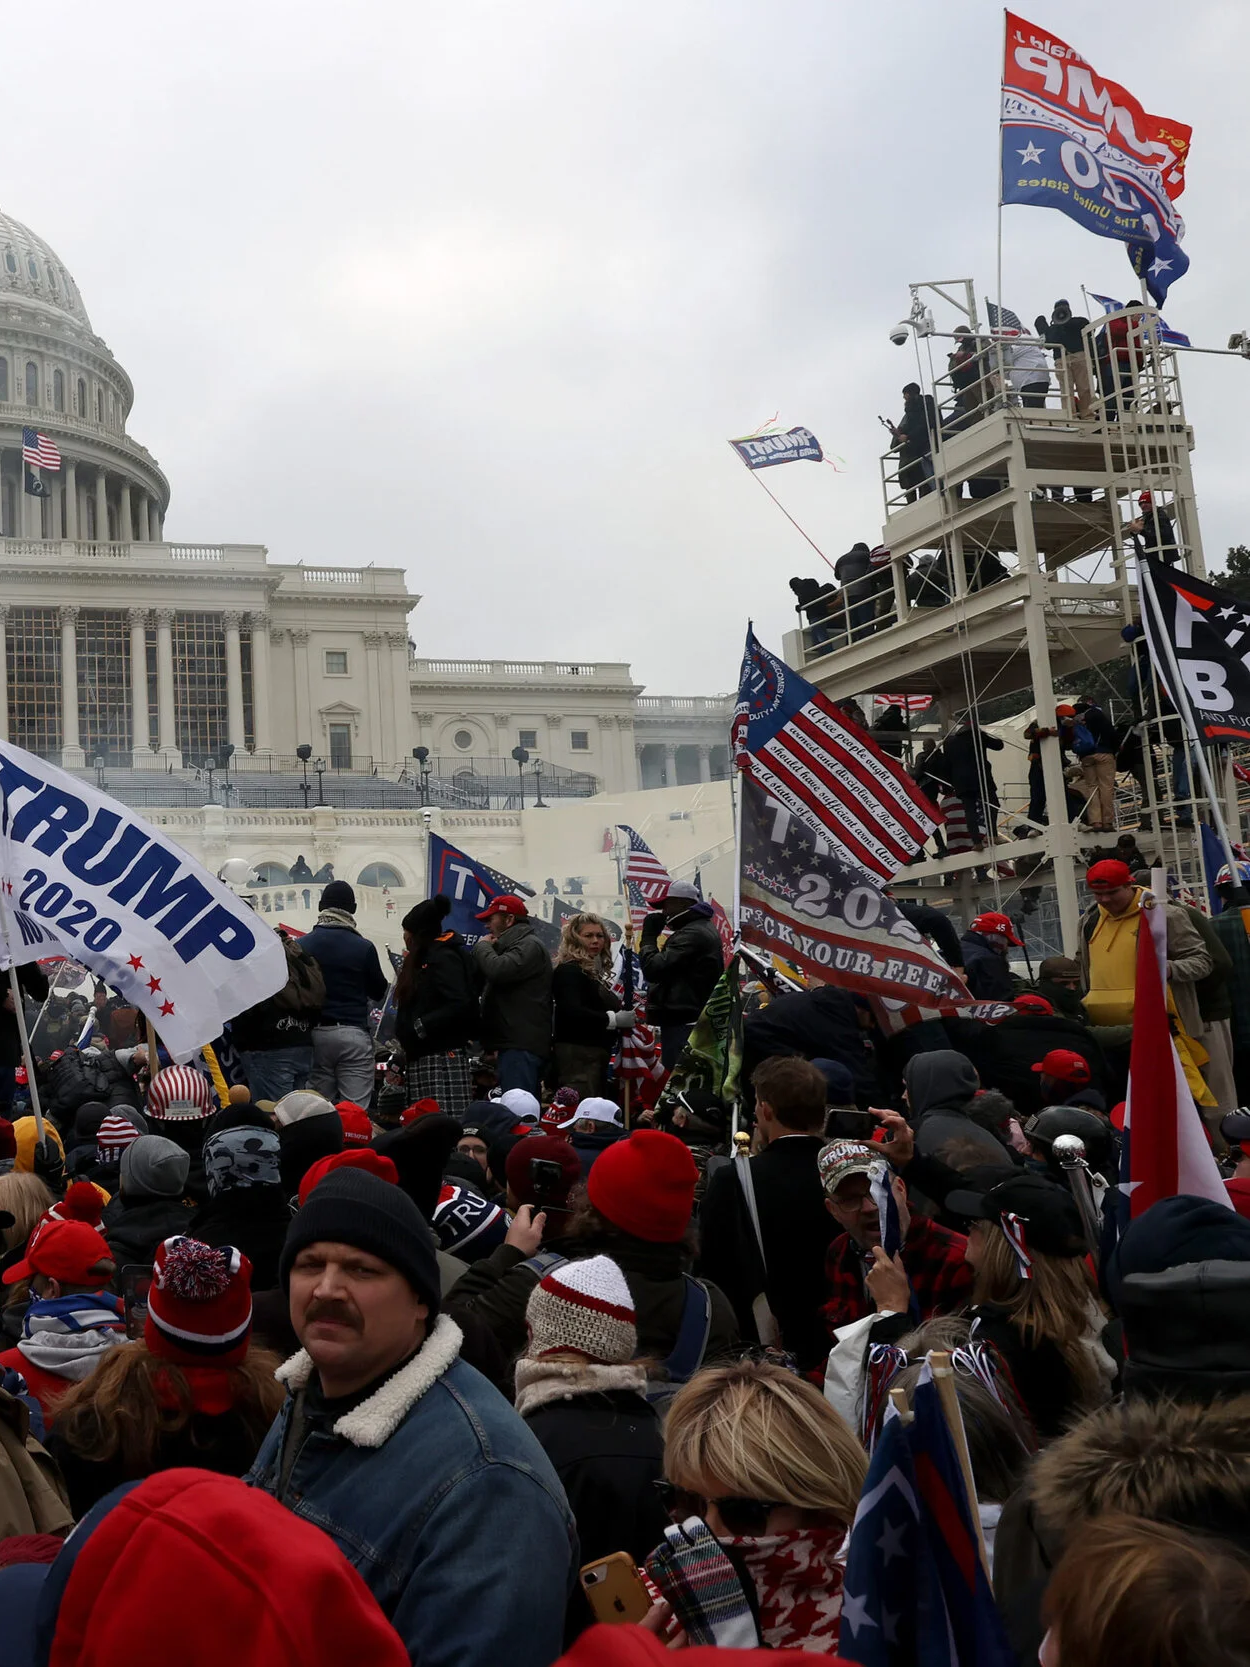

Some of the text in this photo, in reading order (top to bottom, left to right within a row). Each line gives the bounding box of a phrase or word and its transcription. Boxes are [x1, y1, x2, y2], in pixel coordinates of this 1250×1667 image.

[738, 428, 814, 457] TRUMP
[749, 708, 770, 721] DUTY
[807, 707, 928, 827] A free people ought not only Be
[769, 782, 797, 807] status
[796, 806, 810, 818] of
[770, 745, 898, 868] should have sufficient arms And
[789, 727, 916, 852] armed and disciplined, But They
[18, 868, 122, 953] 2020
[996, 923, 1006, 932] 45
[799, 934, 872, 975] YOUR
[822, 1144, 870, 1166] TRUMP
